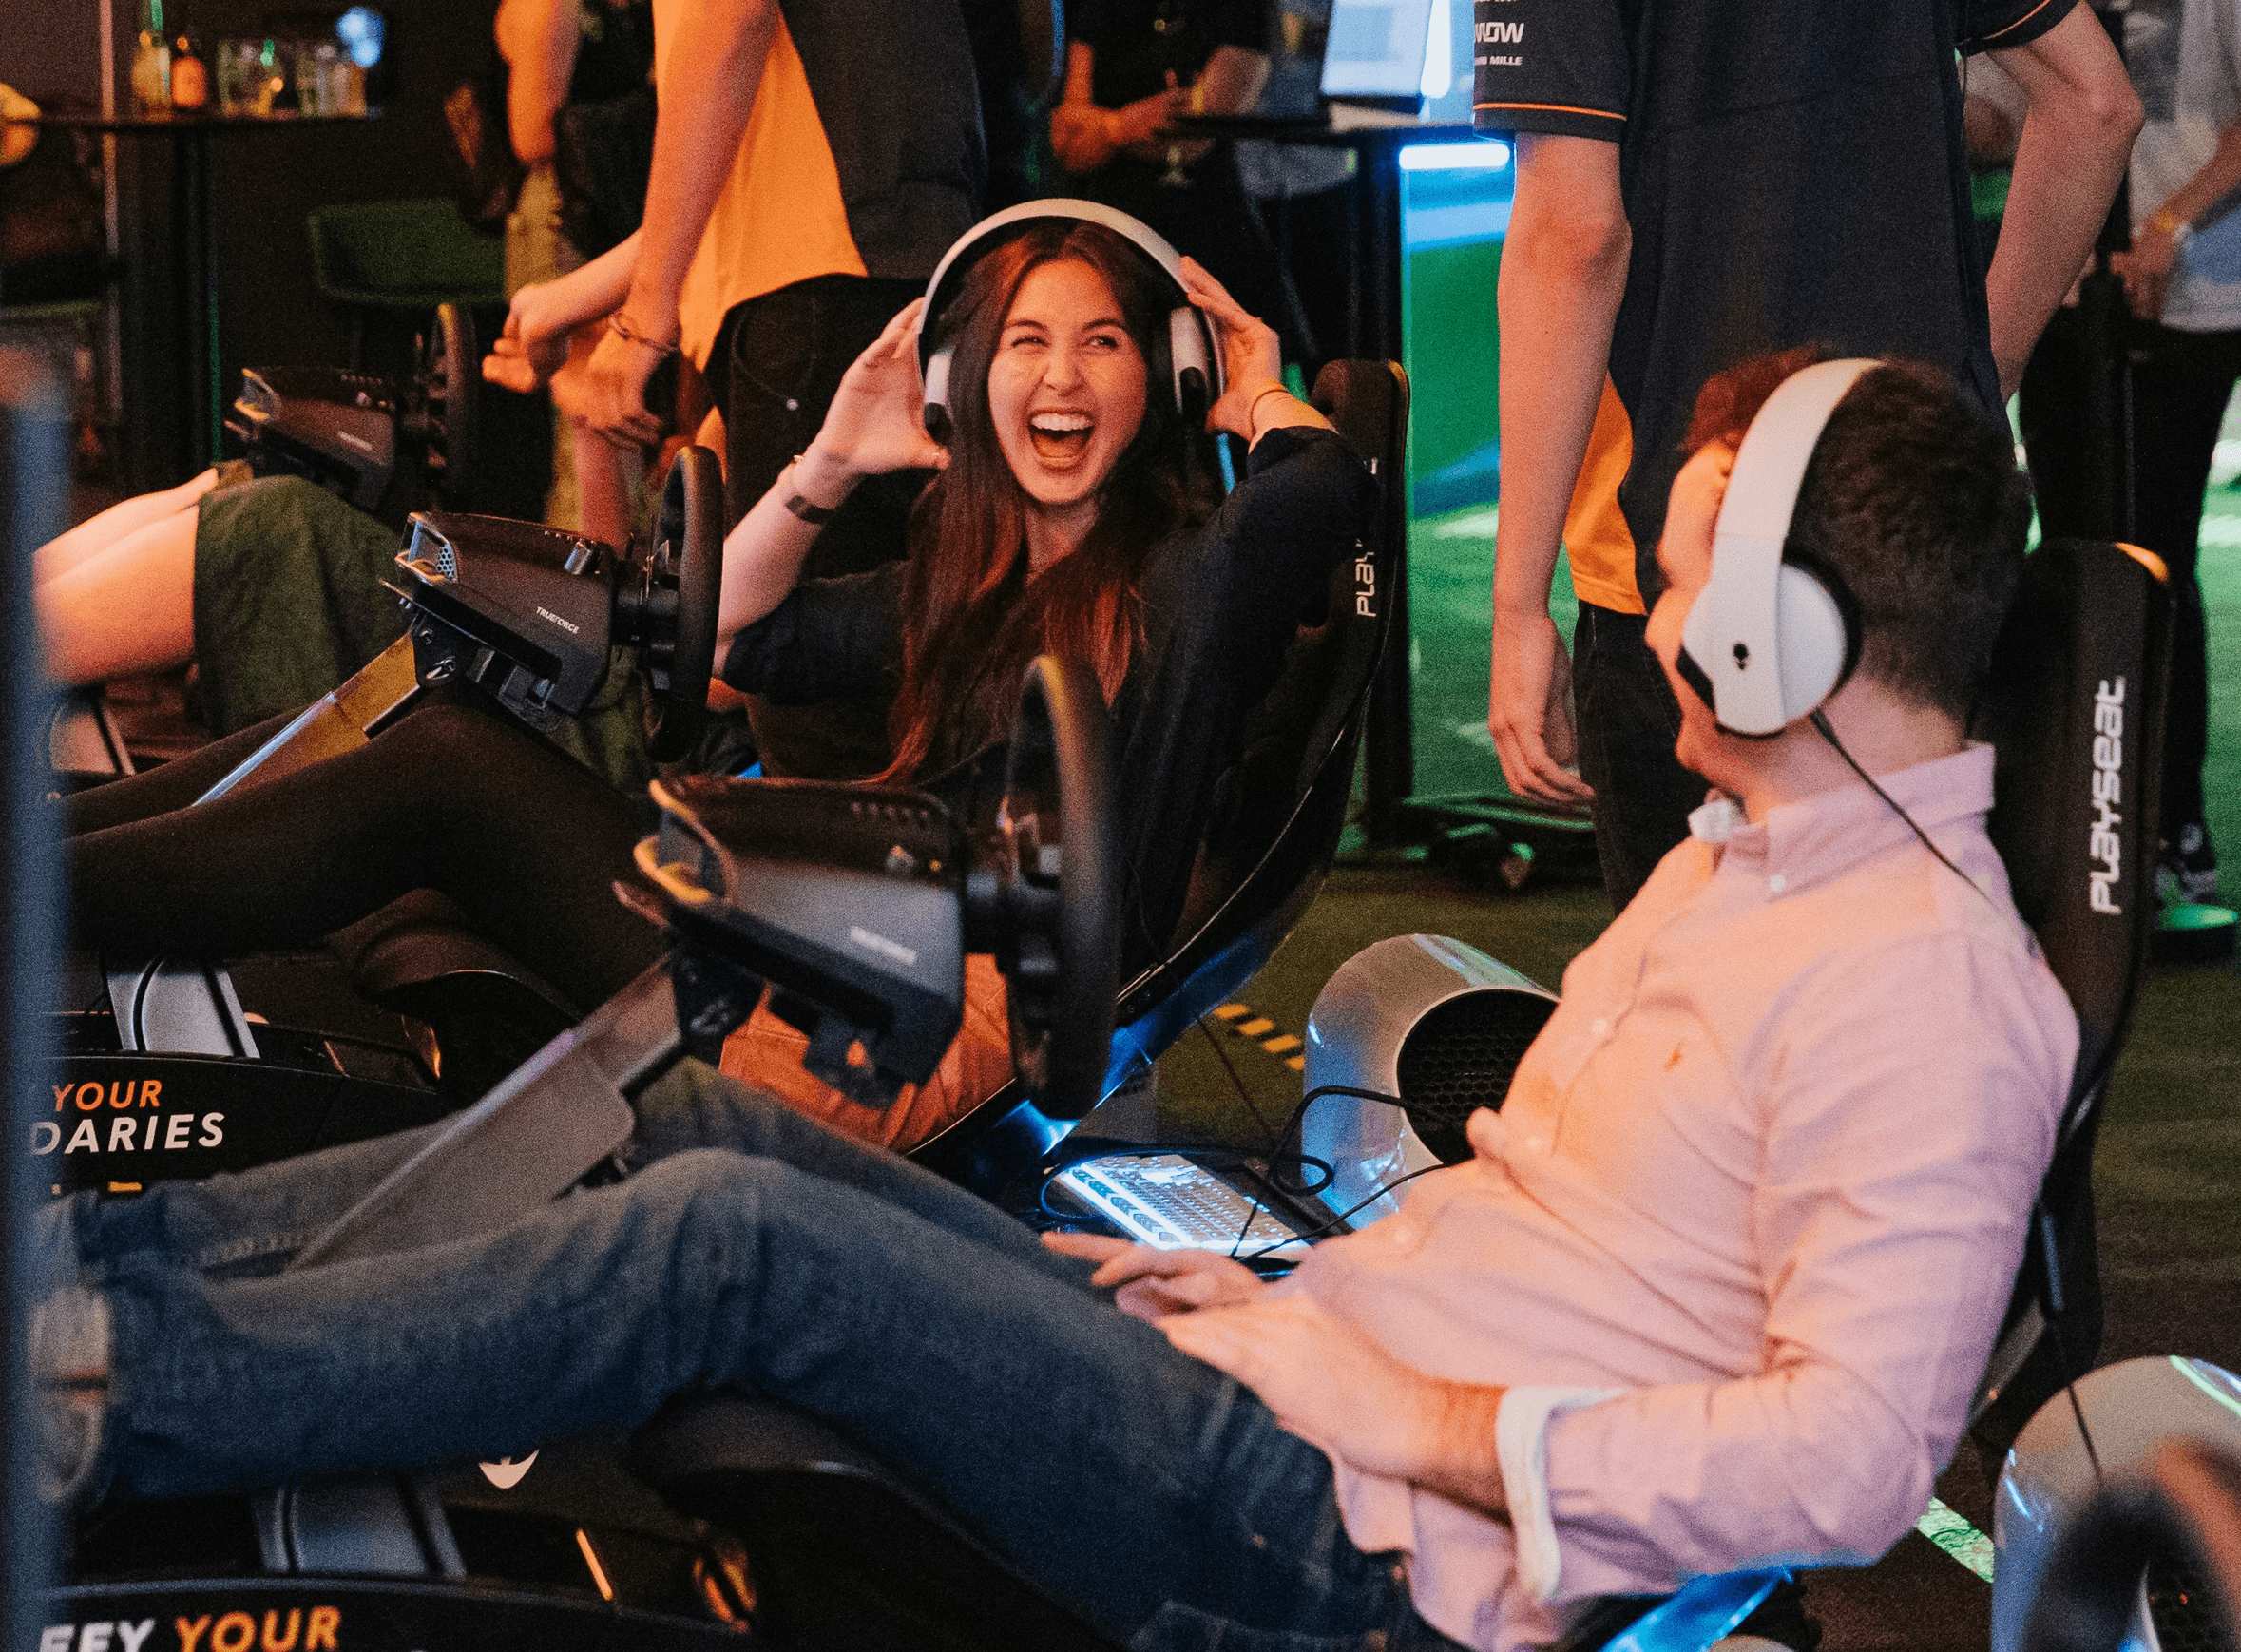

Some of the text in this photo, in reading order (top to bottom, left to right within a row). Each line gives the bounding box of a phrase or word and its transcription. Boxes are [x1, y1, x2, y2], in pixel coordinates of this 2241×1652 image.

[1489, 55, 1523, 66] MILLE
[52, 1080, 163, 1112] YOUR
[175, 1605, 342, 1652] YOUR
